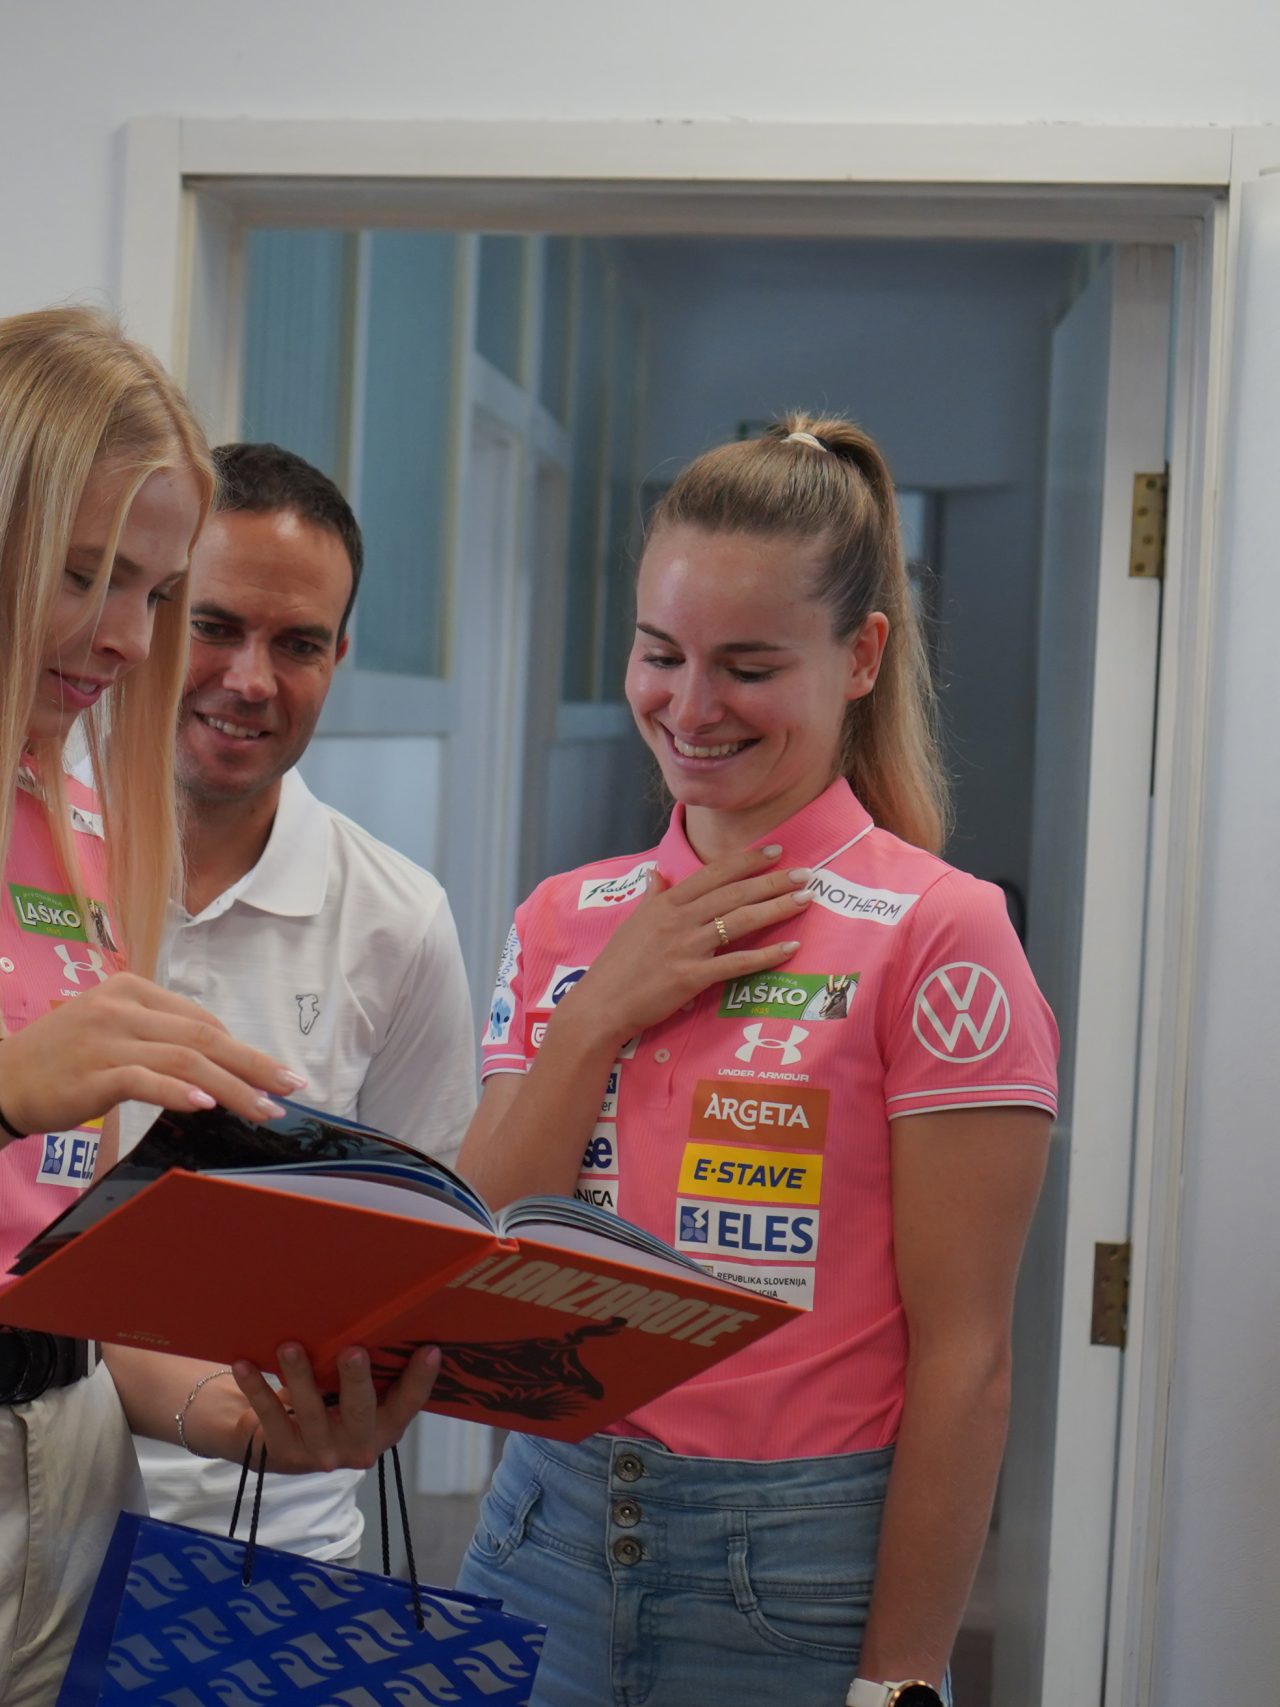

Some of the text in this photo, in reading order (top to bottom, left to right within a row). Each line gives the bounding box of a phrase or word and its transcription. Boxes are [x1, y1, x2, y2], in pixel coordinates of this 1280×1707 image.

[16, 895, 81, 928] LAŠKO
[807, 877, 903, 919] INOTHERM
[726, 982, 808, 1010] LAŠKO
[718, 1068, 810, 1082] UNDER ARMOUR
[704, 1092, 810, 1131] ARGETA
[582, 1137, 613, 1169] se
[576, 1190, 614, 1208] NICA
[718, 1210, 814, 1255] ELES
[717, 1272, 807, 1288] REPUBLIKA SLOVENIJA
[465, 1254, 761, 1348] LANZAROTE
